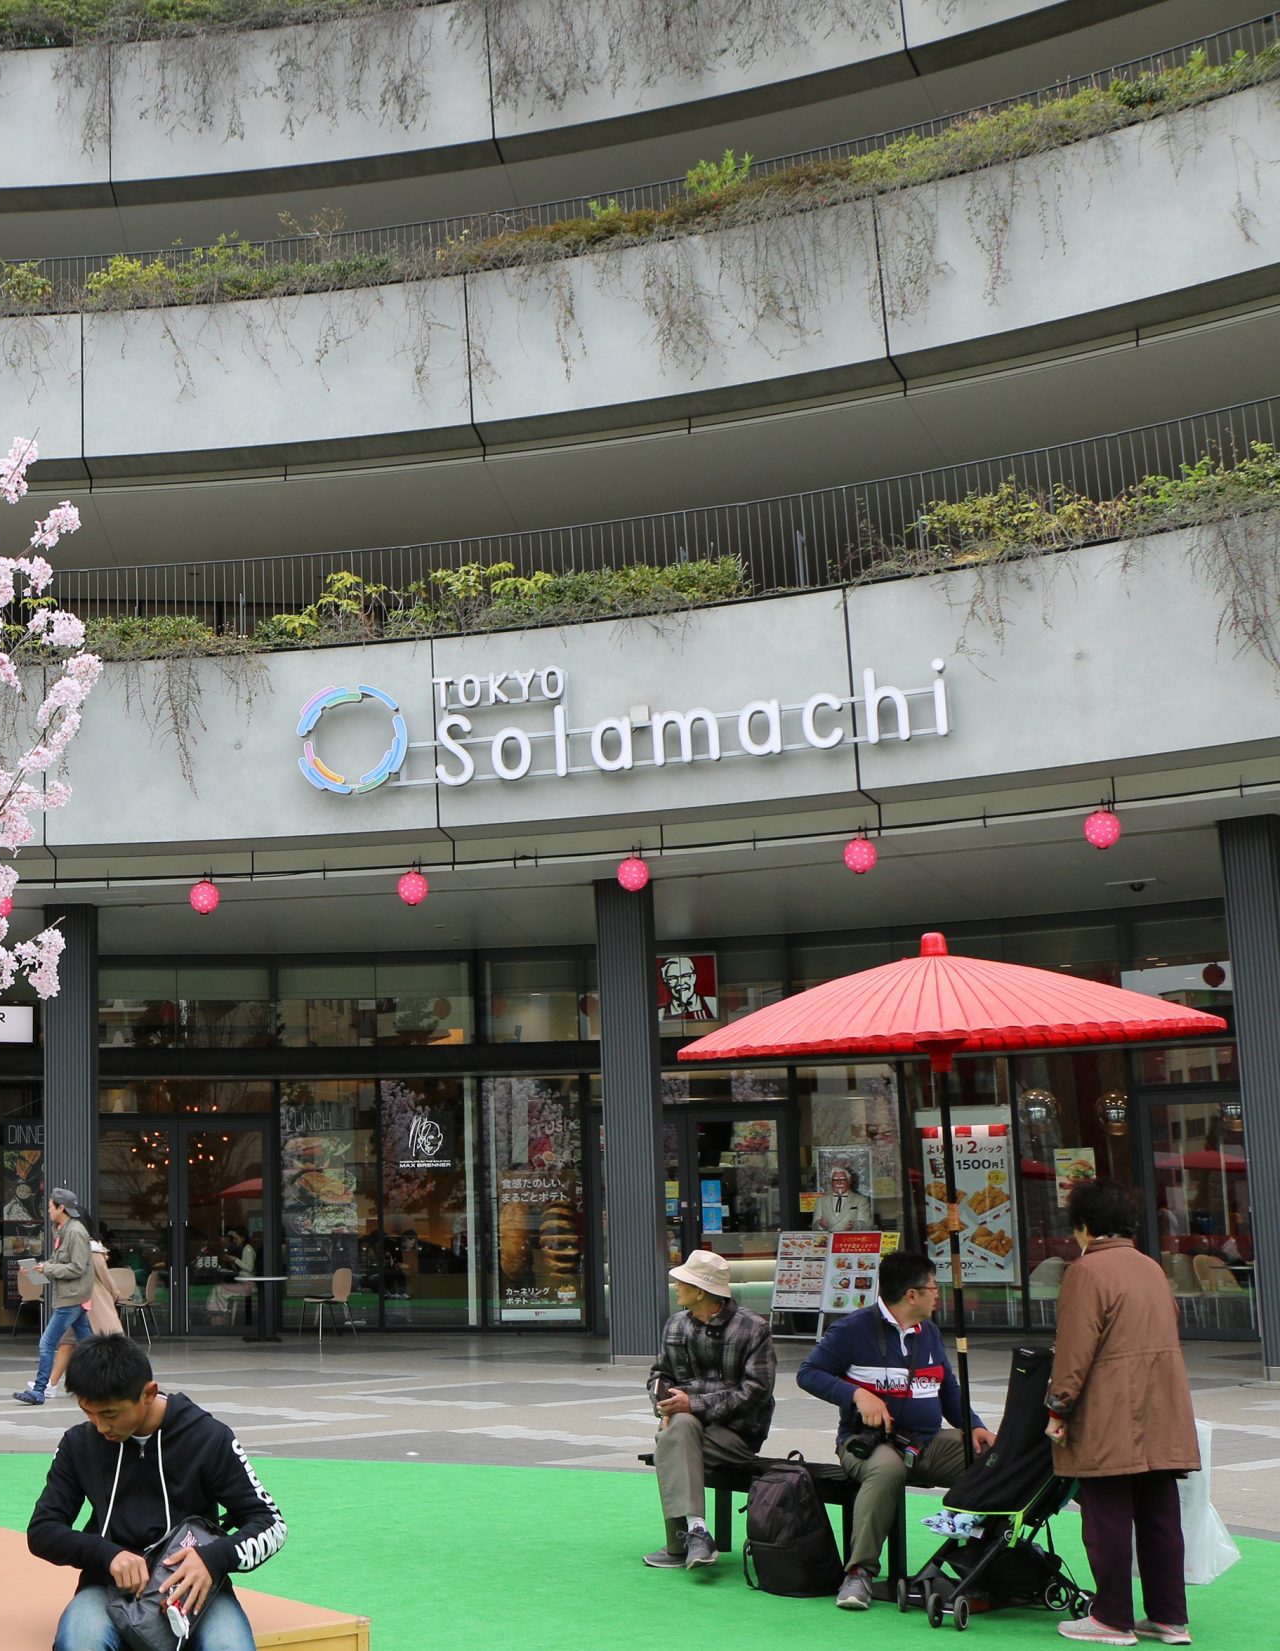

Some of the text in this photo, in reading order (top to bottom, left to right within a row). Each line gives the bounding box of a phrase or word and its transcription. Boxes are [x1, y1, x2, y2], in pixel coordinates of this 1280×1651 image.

[433, 665, 565, 710] TOKYO
[434, 657, 951, 787] Solamachi
[8, 1124, 45, 1145] DINNE
[285, 1111, 332, 1132] LUNCH
